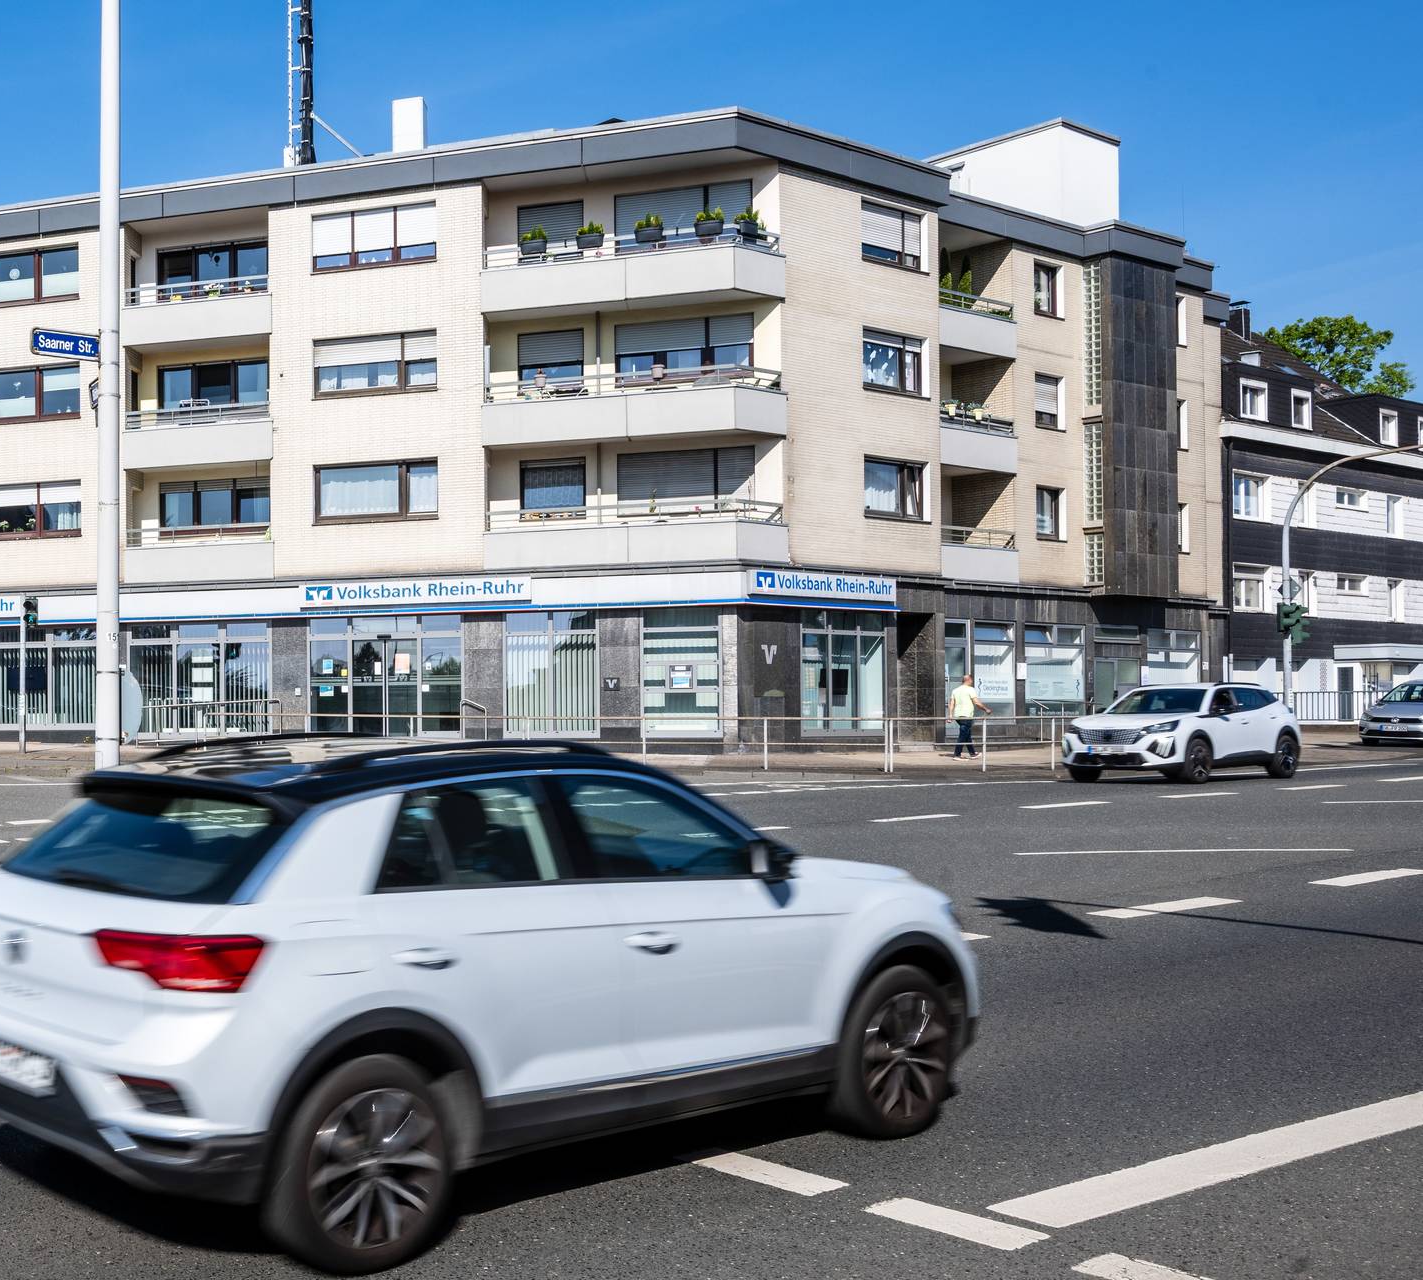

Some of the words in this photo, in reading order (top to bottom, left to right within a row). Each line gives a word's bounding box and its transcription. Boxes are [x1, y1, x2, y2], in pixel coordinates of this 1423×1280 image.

[38, 334, 74, 351] Saarner
[78, 340, 94, 354] Str.
[336, 582, 422, 600] Volksbank
[427, 580, 525, 597] Rhein-Ruhr
[777, 574, 833, 592] Volksbank
[836, 577, 893, 596] Rhein-Ruhr
